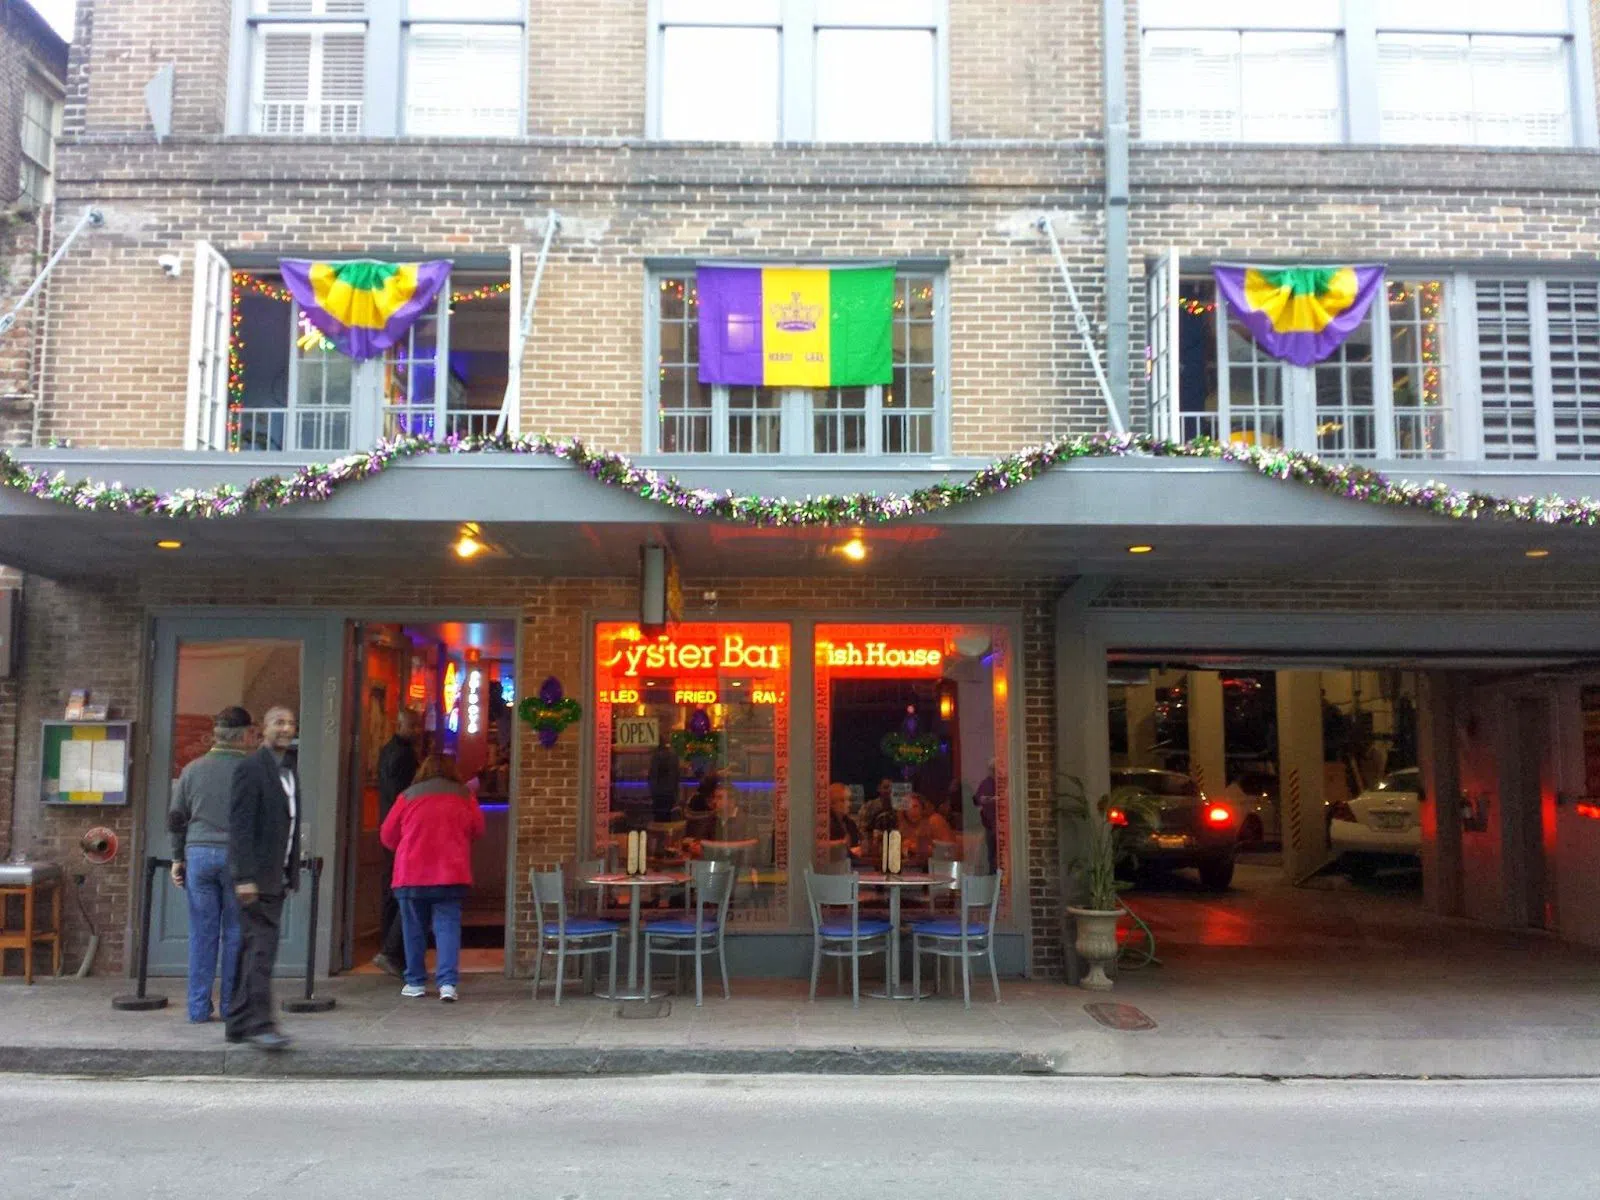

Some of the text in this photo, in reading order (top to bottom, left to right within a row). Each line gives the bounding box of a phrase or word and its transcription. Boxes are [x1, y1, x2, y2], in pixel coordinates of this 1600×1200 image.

[866, 642, 941, 667] House
[675, 690, 717, 704] FRIED
[620, 722, 656, 745] OPEN
[816, 722, 828, 773] SHRIMP
[816, 783, 828, 815] RICE
